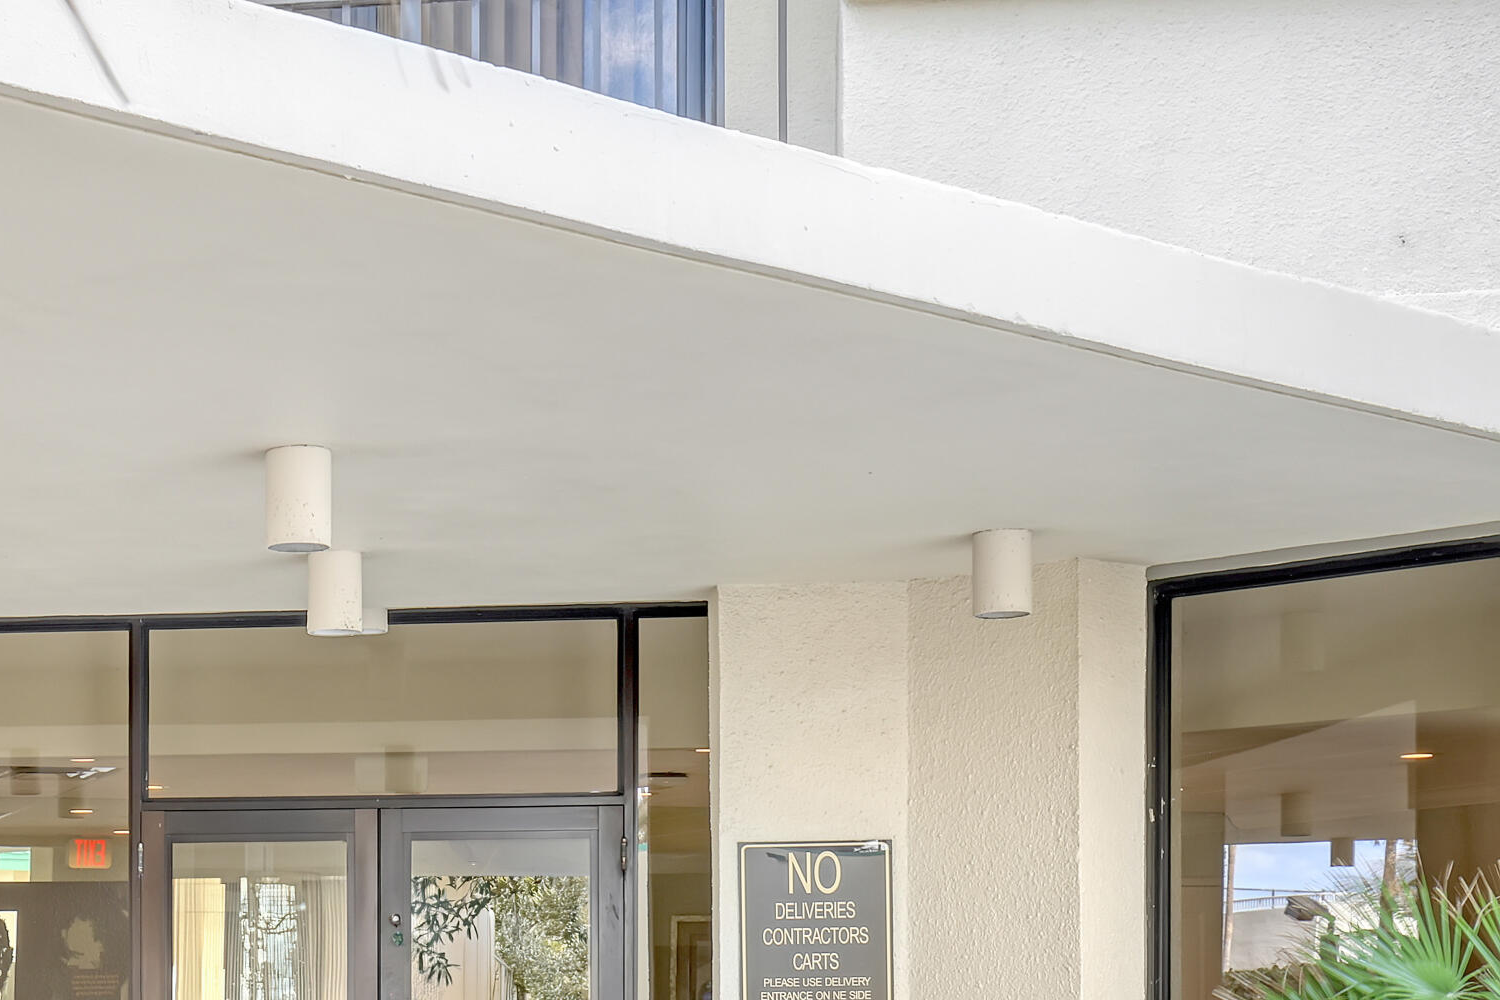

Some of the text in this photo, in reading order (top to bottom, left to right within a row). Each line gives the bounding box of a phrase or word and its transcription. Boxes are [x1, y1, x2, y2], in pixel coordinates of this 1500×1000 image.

[788, 850, 842, 895] NO
[775, 901, 856, 920] DELIVERIES
[762, 926, 869, 945] CONTRACTORS
[793, 952, 840, 970] CARTS
[763, 976, 872, 988] PLEASE USE DELIVERY
[815, 991, 832, 1000] ON
[832, 990, 846, 1000] NE
[849, 990, 872, 1000] SIDE
